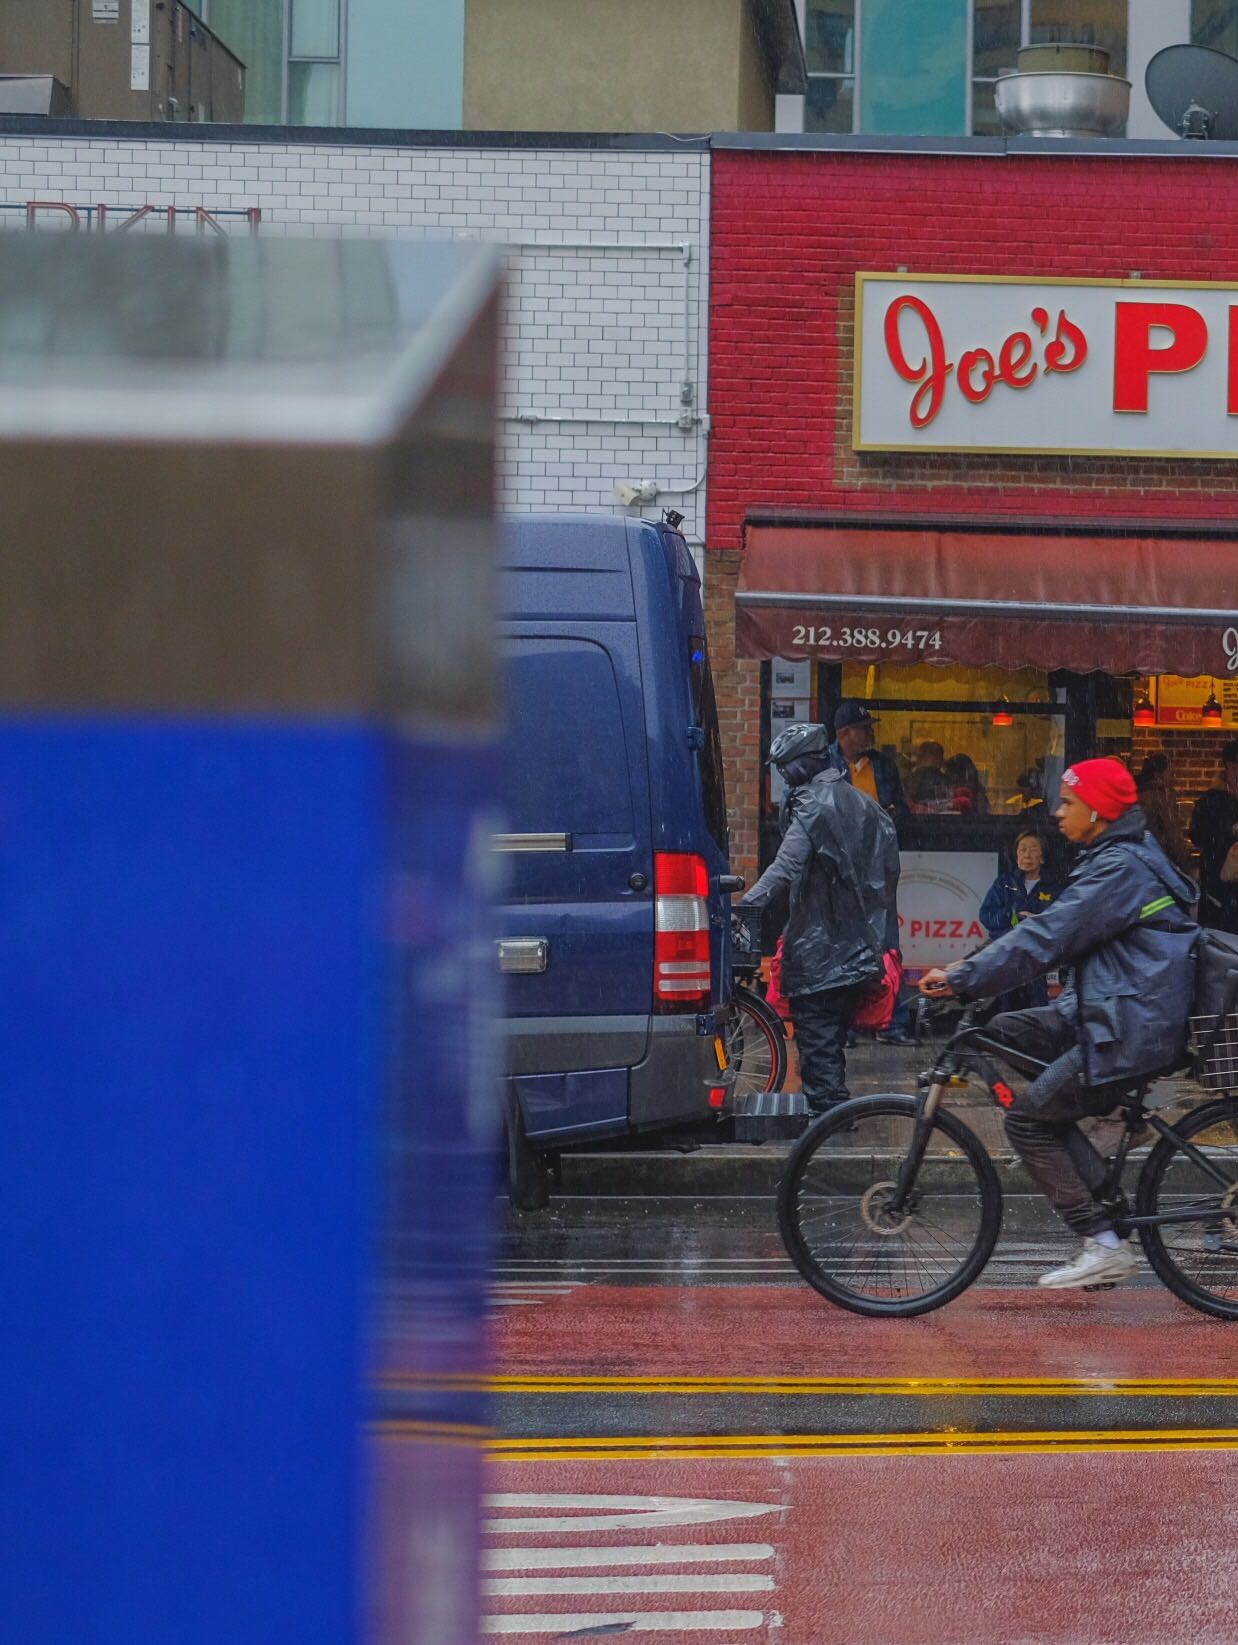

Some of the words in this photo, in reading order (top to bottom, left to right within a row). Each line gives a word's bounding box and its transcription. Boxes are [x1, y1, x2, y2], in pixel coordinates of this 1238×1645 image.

[884, 295, 1088, 429] Joe's
[792, 625, 942, 650] 212.388.9474
[910, 920, 984, 939] PIZZA
